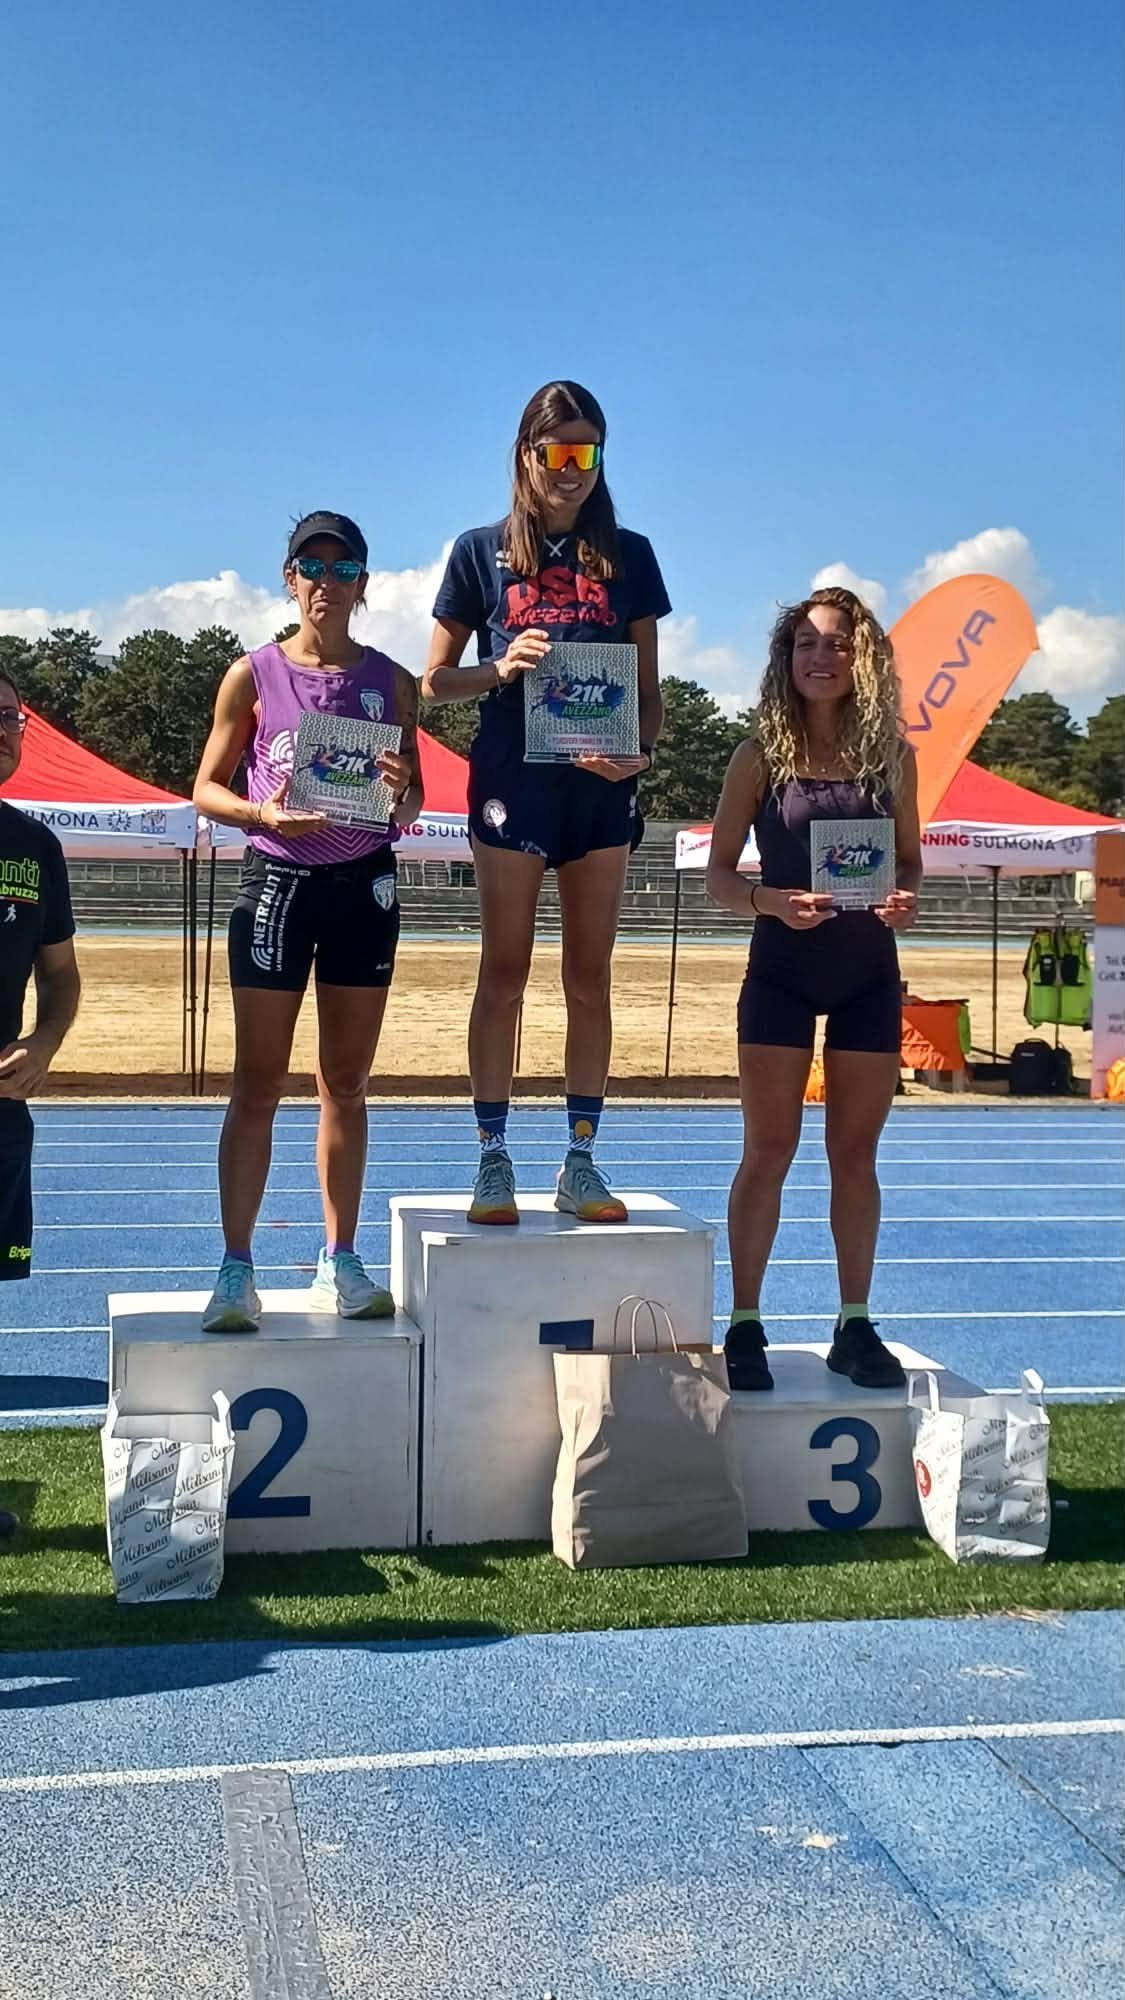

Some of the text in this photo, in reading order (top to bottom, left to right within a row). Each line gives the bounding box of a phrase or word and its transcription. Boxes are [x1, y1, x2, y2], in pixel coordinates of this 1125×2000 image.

[567, 684, 608, 703] 21K
[332, 754, 371, 774] 21K
[25, 811, 100, 828] MONA
[400, 823, 424, 837] NG
[973, 834, 1056, 851] SULMONA
[843, 850, 872, 865] 21K
[0, 858, 41, 888] nti
[227, 1387, 310, 1520] 2
[808, 1416, 882, 1532] 3
